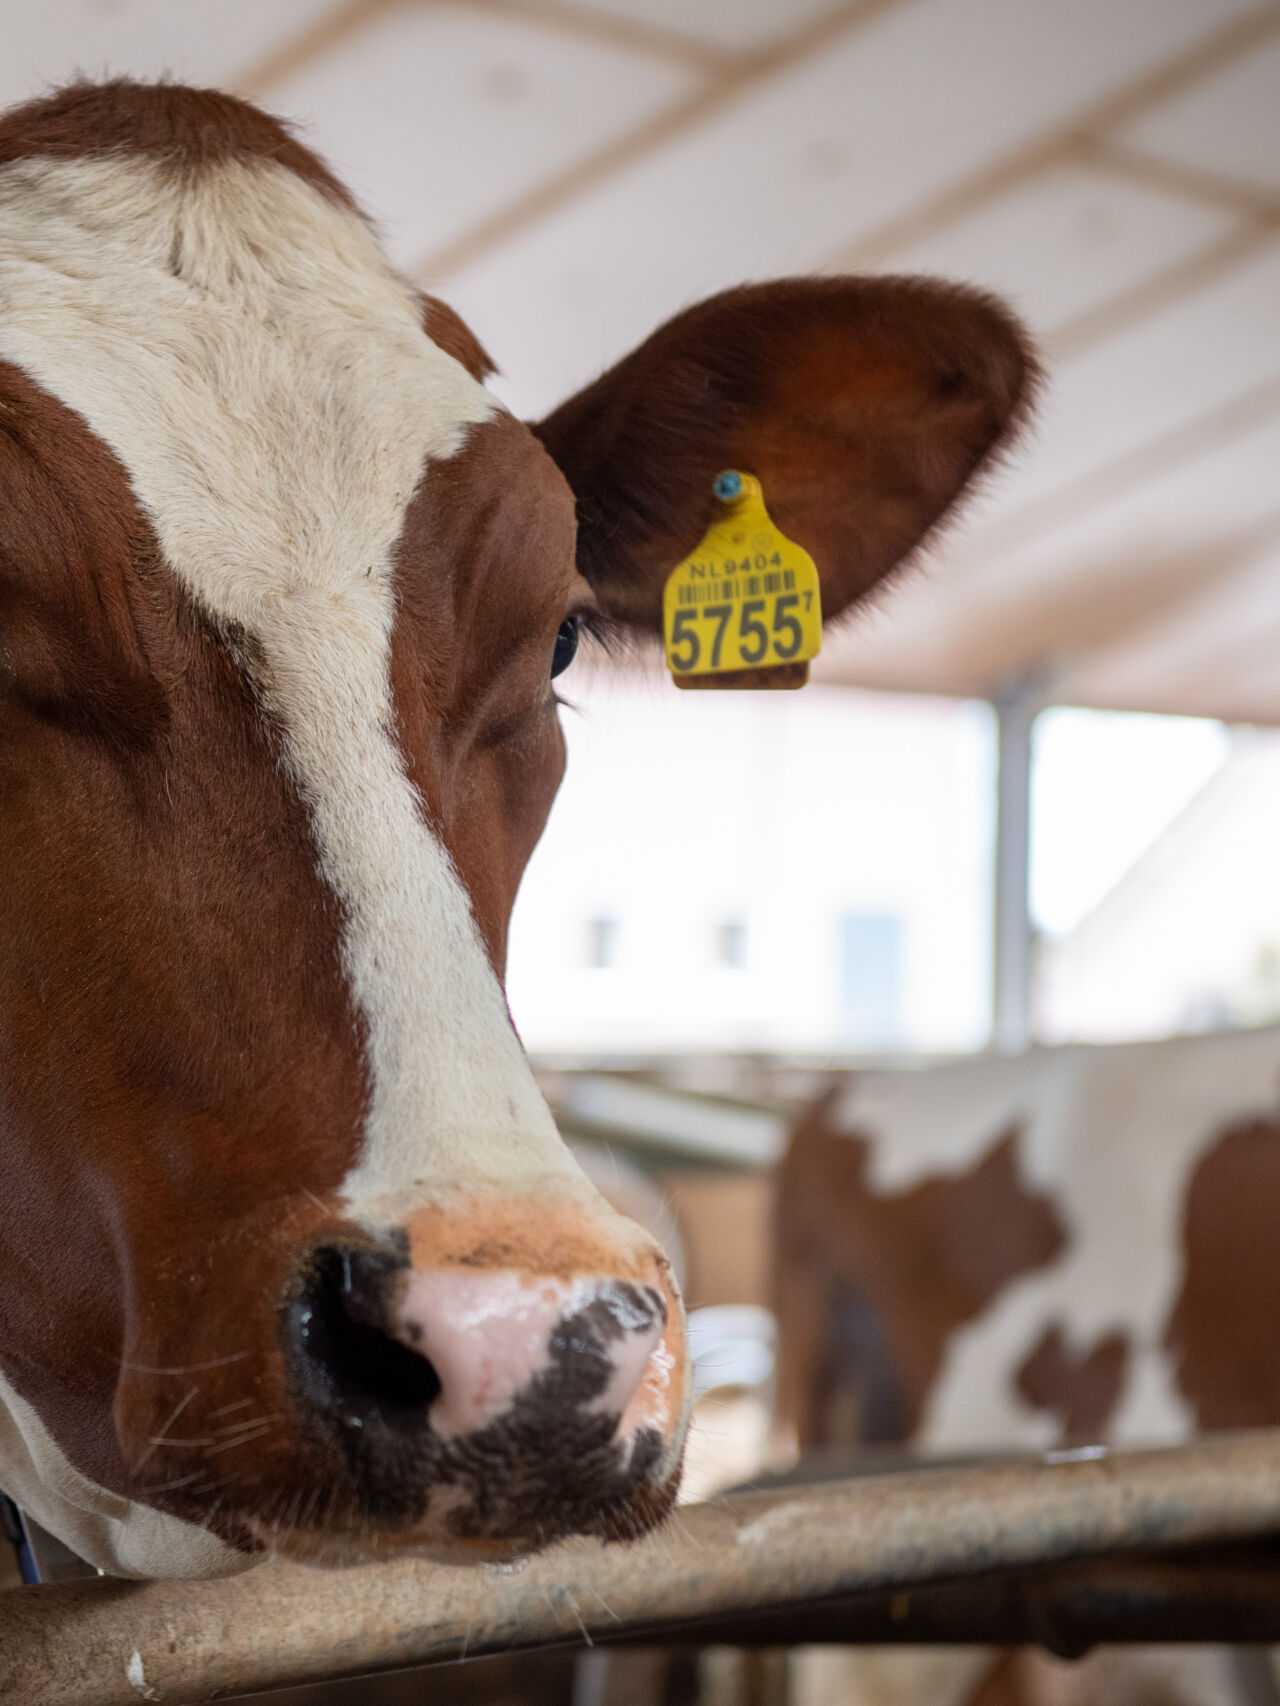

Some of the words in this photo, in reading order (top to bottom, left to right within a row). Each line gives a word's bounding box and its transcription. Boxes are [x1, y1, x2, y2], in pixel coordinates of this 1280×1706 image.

[689, 551, 782, 579] NL9404
[670, 595, 803, 671] 5755
[803, 591, 815, 612] 7
